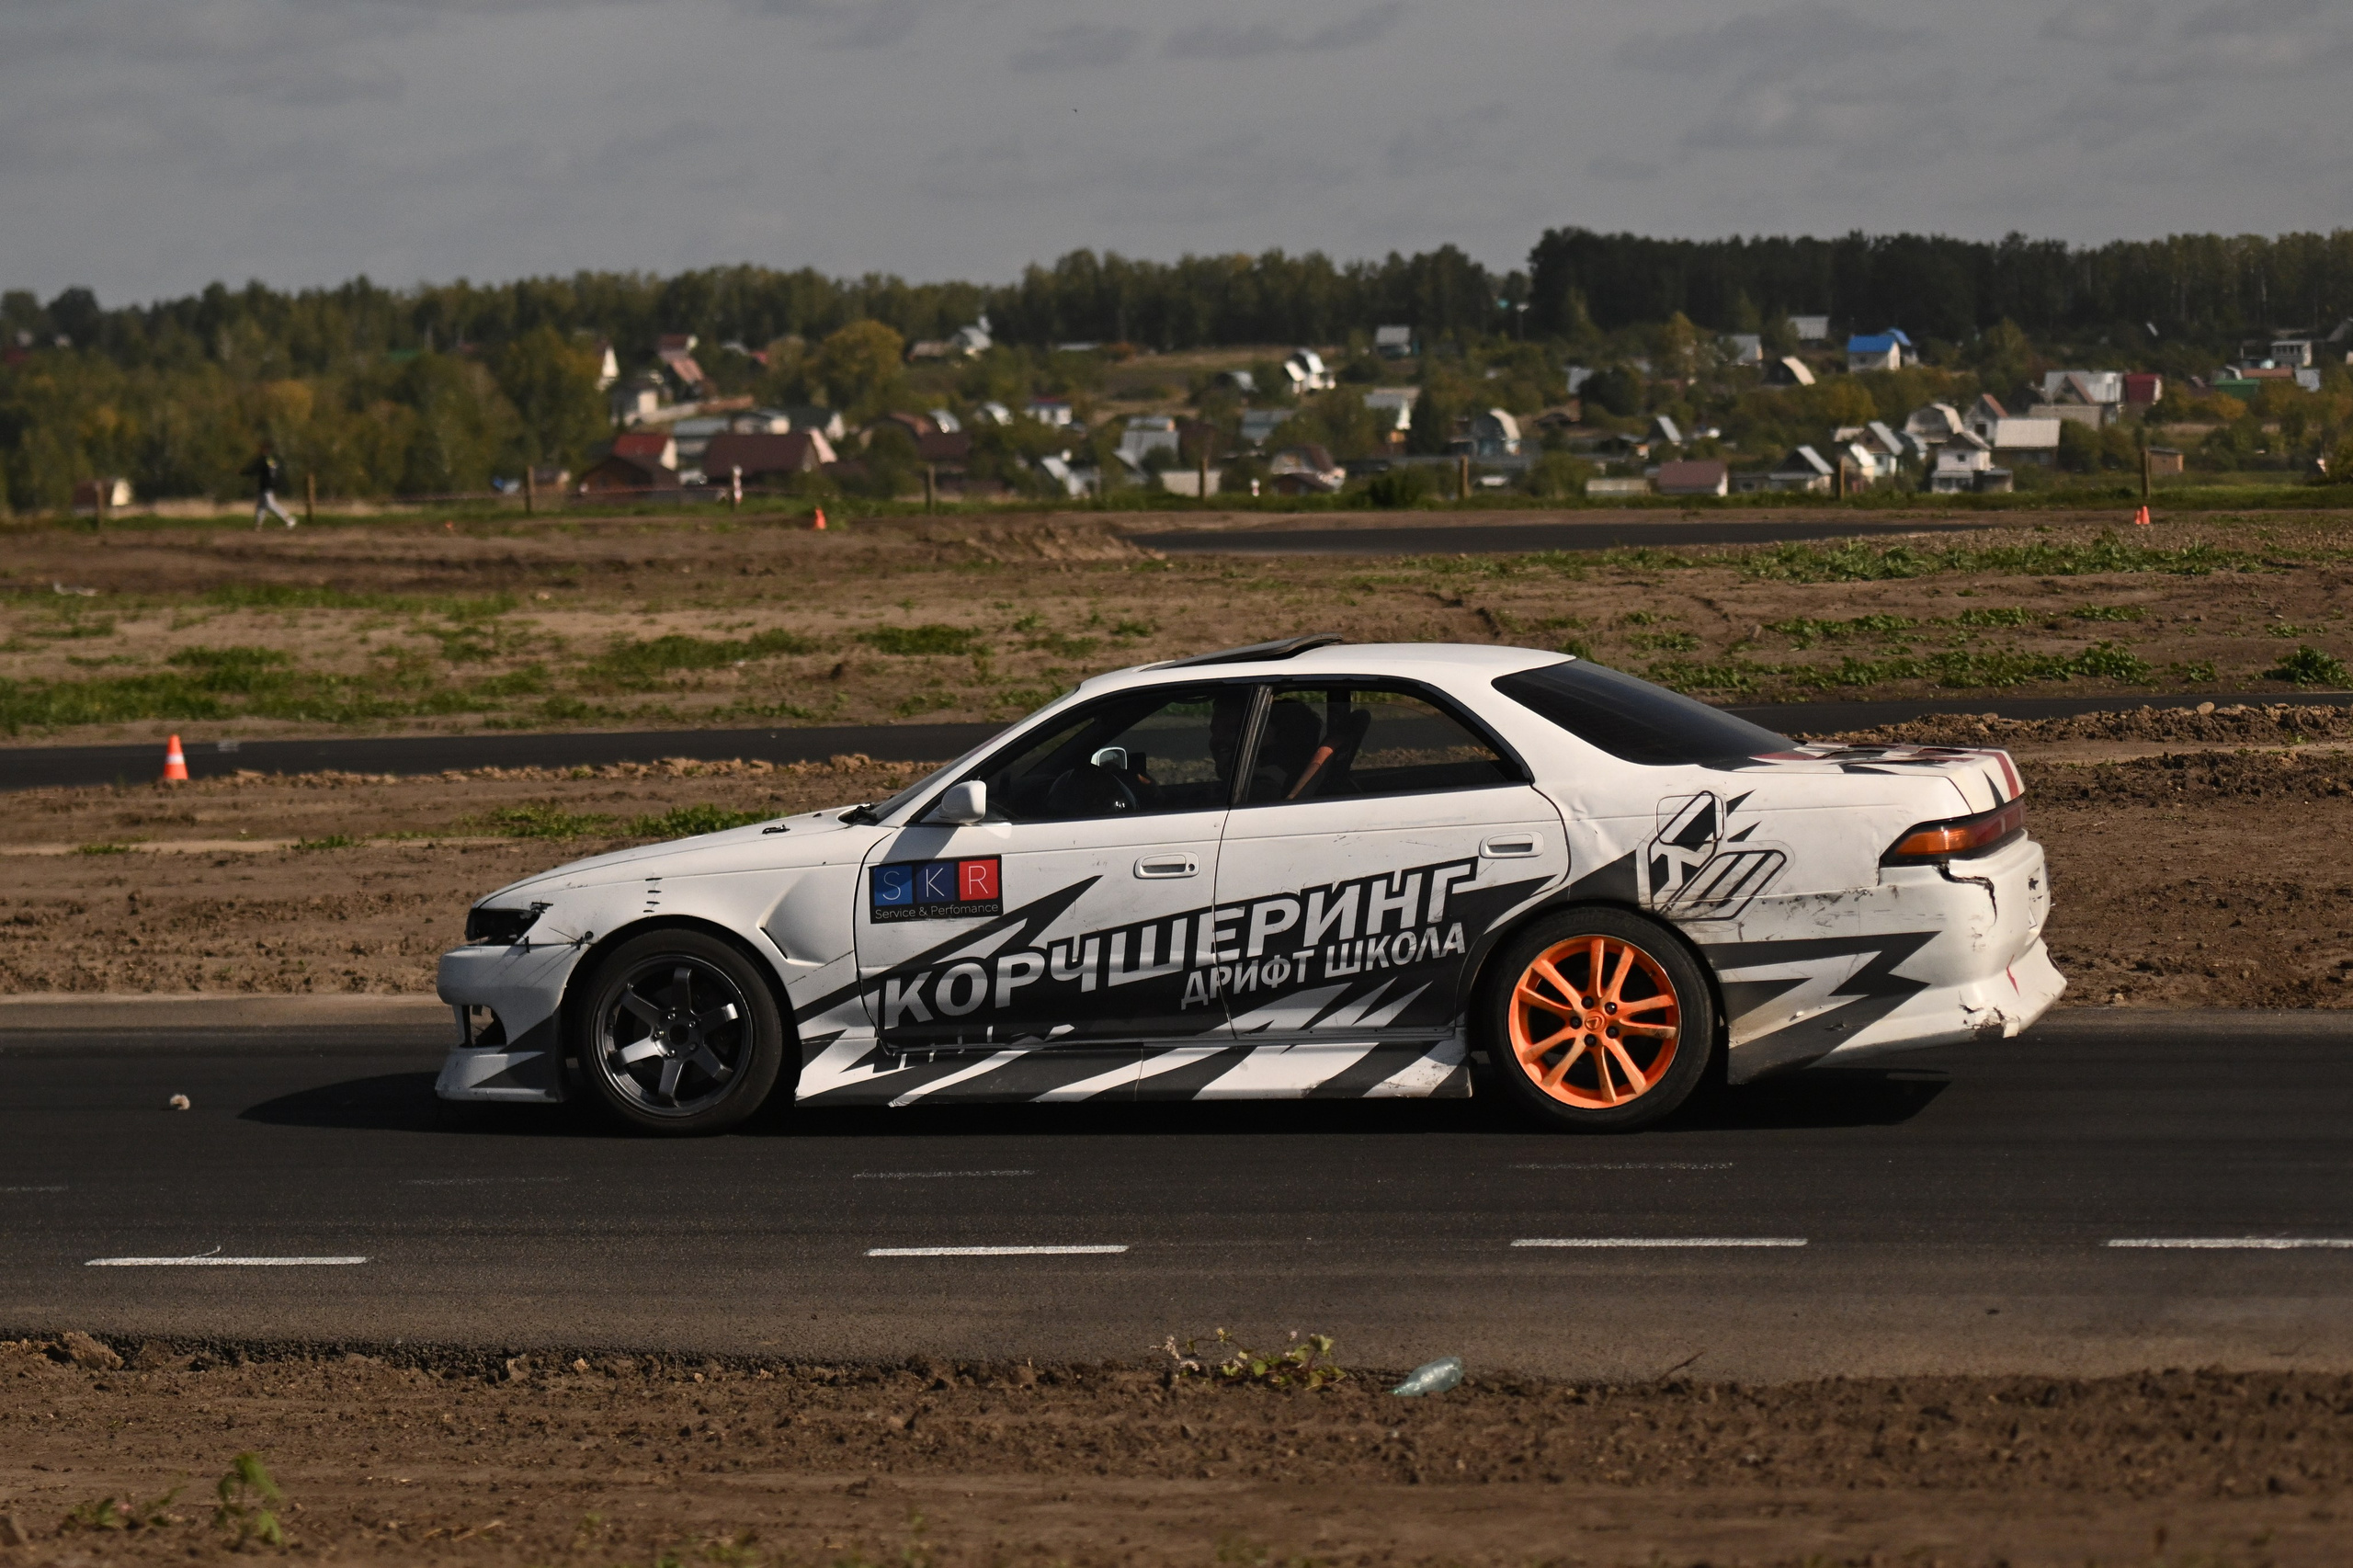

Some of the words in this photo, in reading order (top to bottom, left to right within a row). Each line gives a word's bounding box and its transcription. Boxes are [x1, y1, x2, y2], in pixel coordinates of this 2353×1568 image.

[875, 907, 916, 919] Service
[918, 906, 928, 916] &
[930, 903, 999, 915] Perfomance
[882, 865, 989, 901] SKR
[884, 864, 1472, 1029] КОРЧШЕРИНГ
[1181, 949, 1315, 1010] ДРИФТ
[1324, 922, 1466, 979] ШКОЛА
